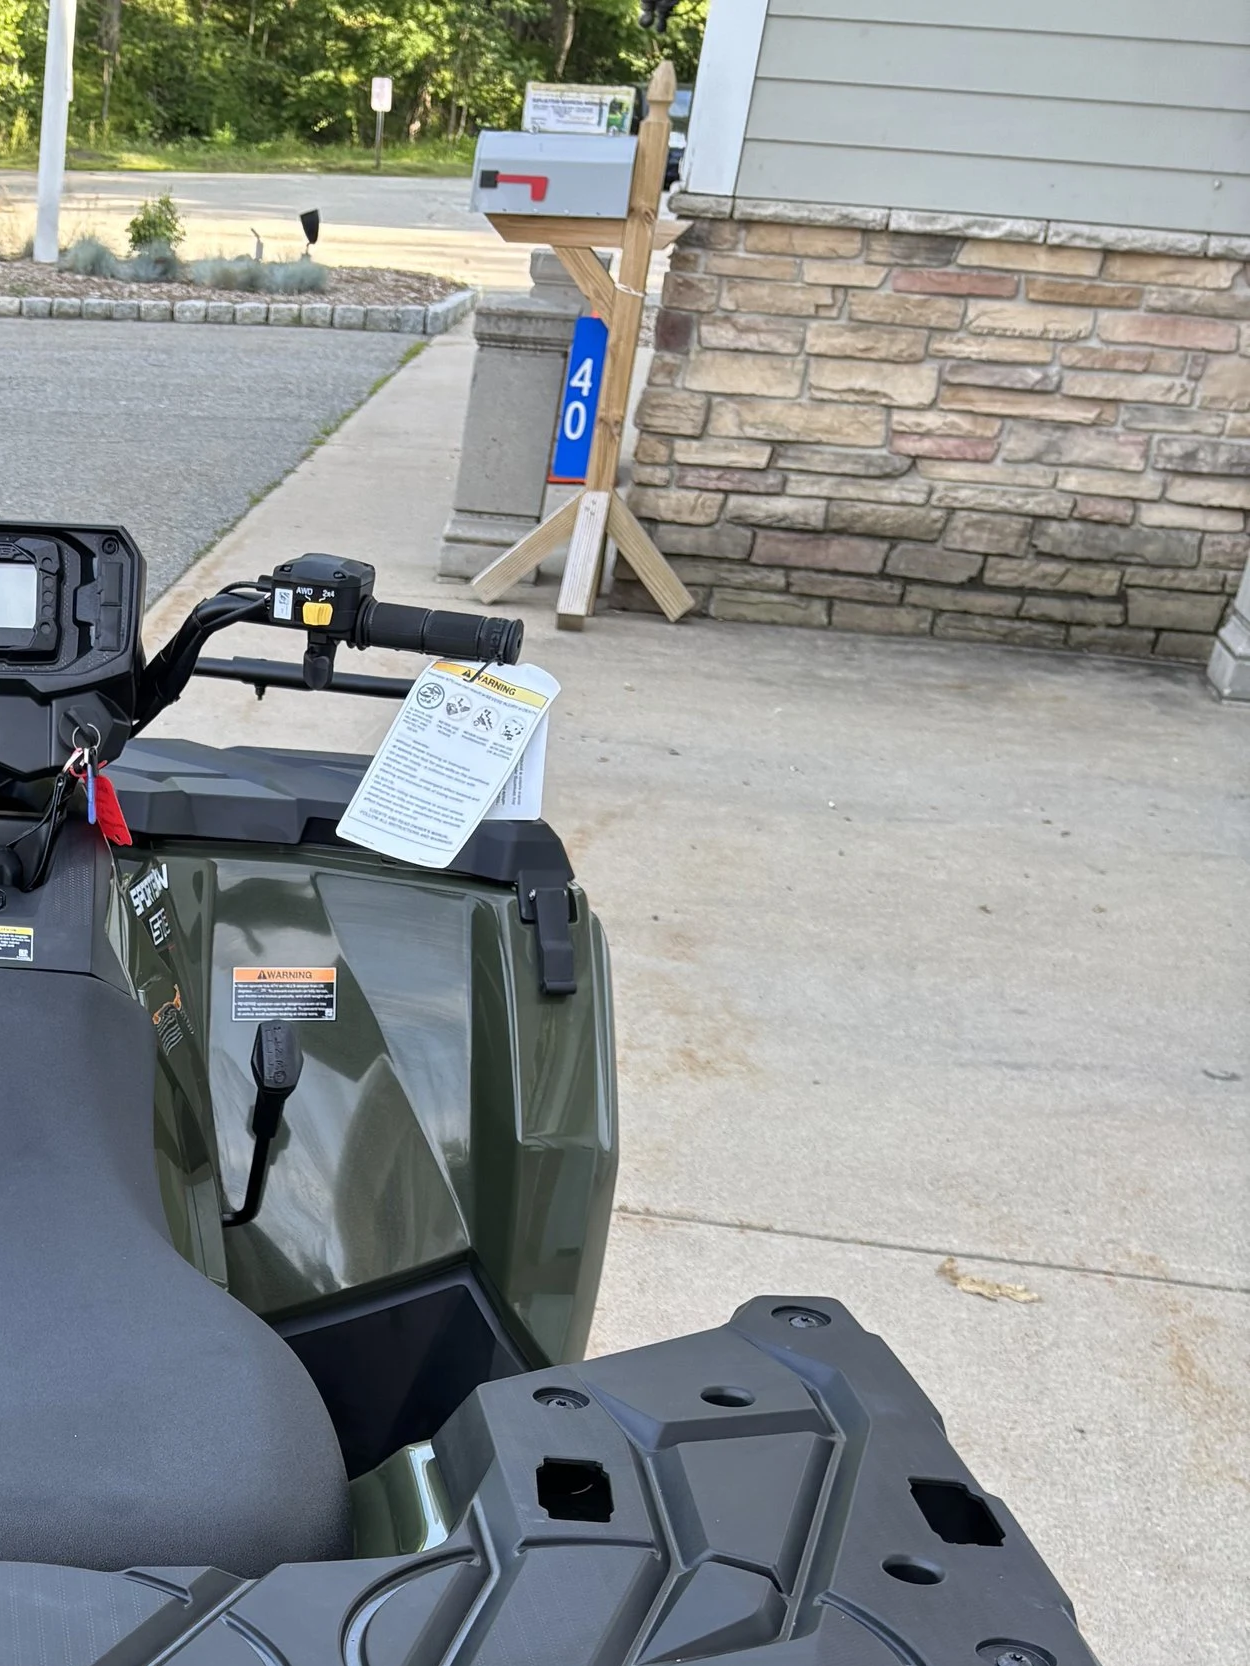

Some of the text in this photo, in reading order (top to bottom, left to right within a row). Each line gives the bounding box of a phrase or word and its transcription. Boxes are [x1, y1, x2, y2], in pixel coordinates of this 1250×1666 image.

[564, 358, 593, 440] 40
[296, 587, 335, 599] AWD 2x4
[266, 970, 313, 980] WARNING
